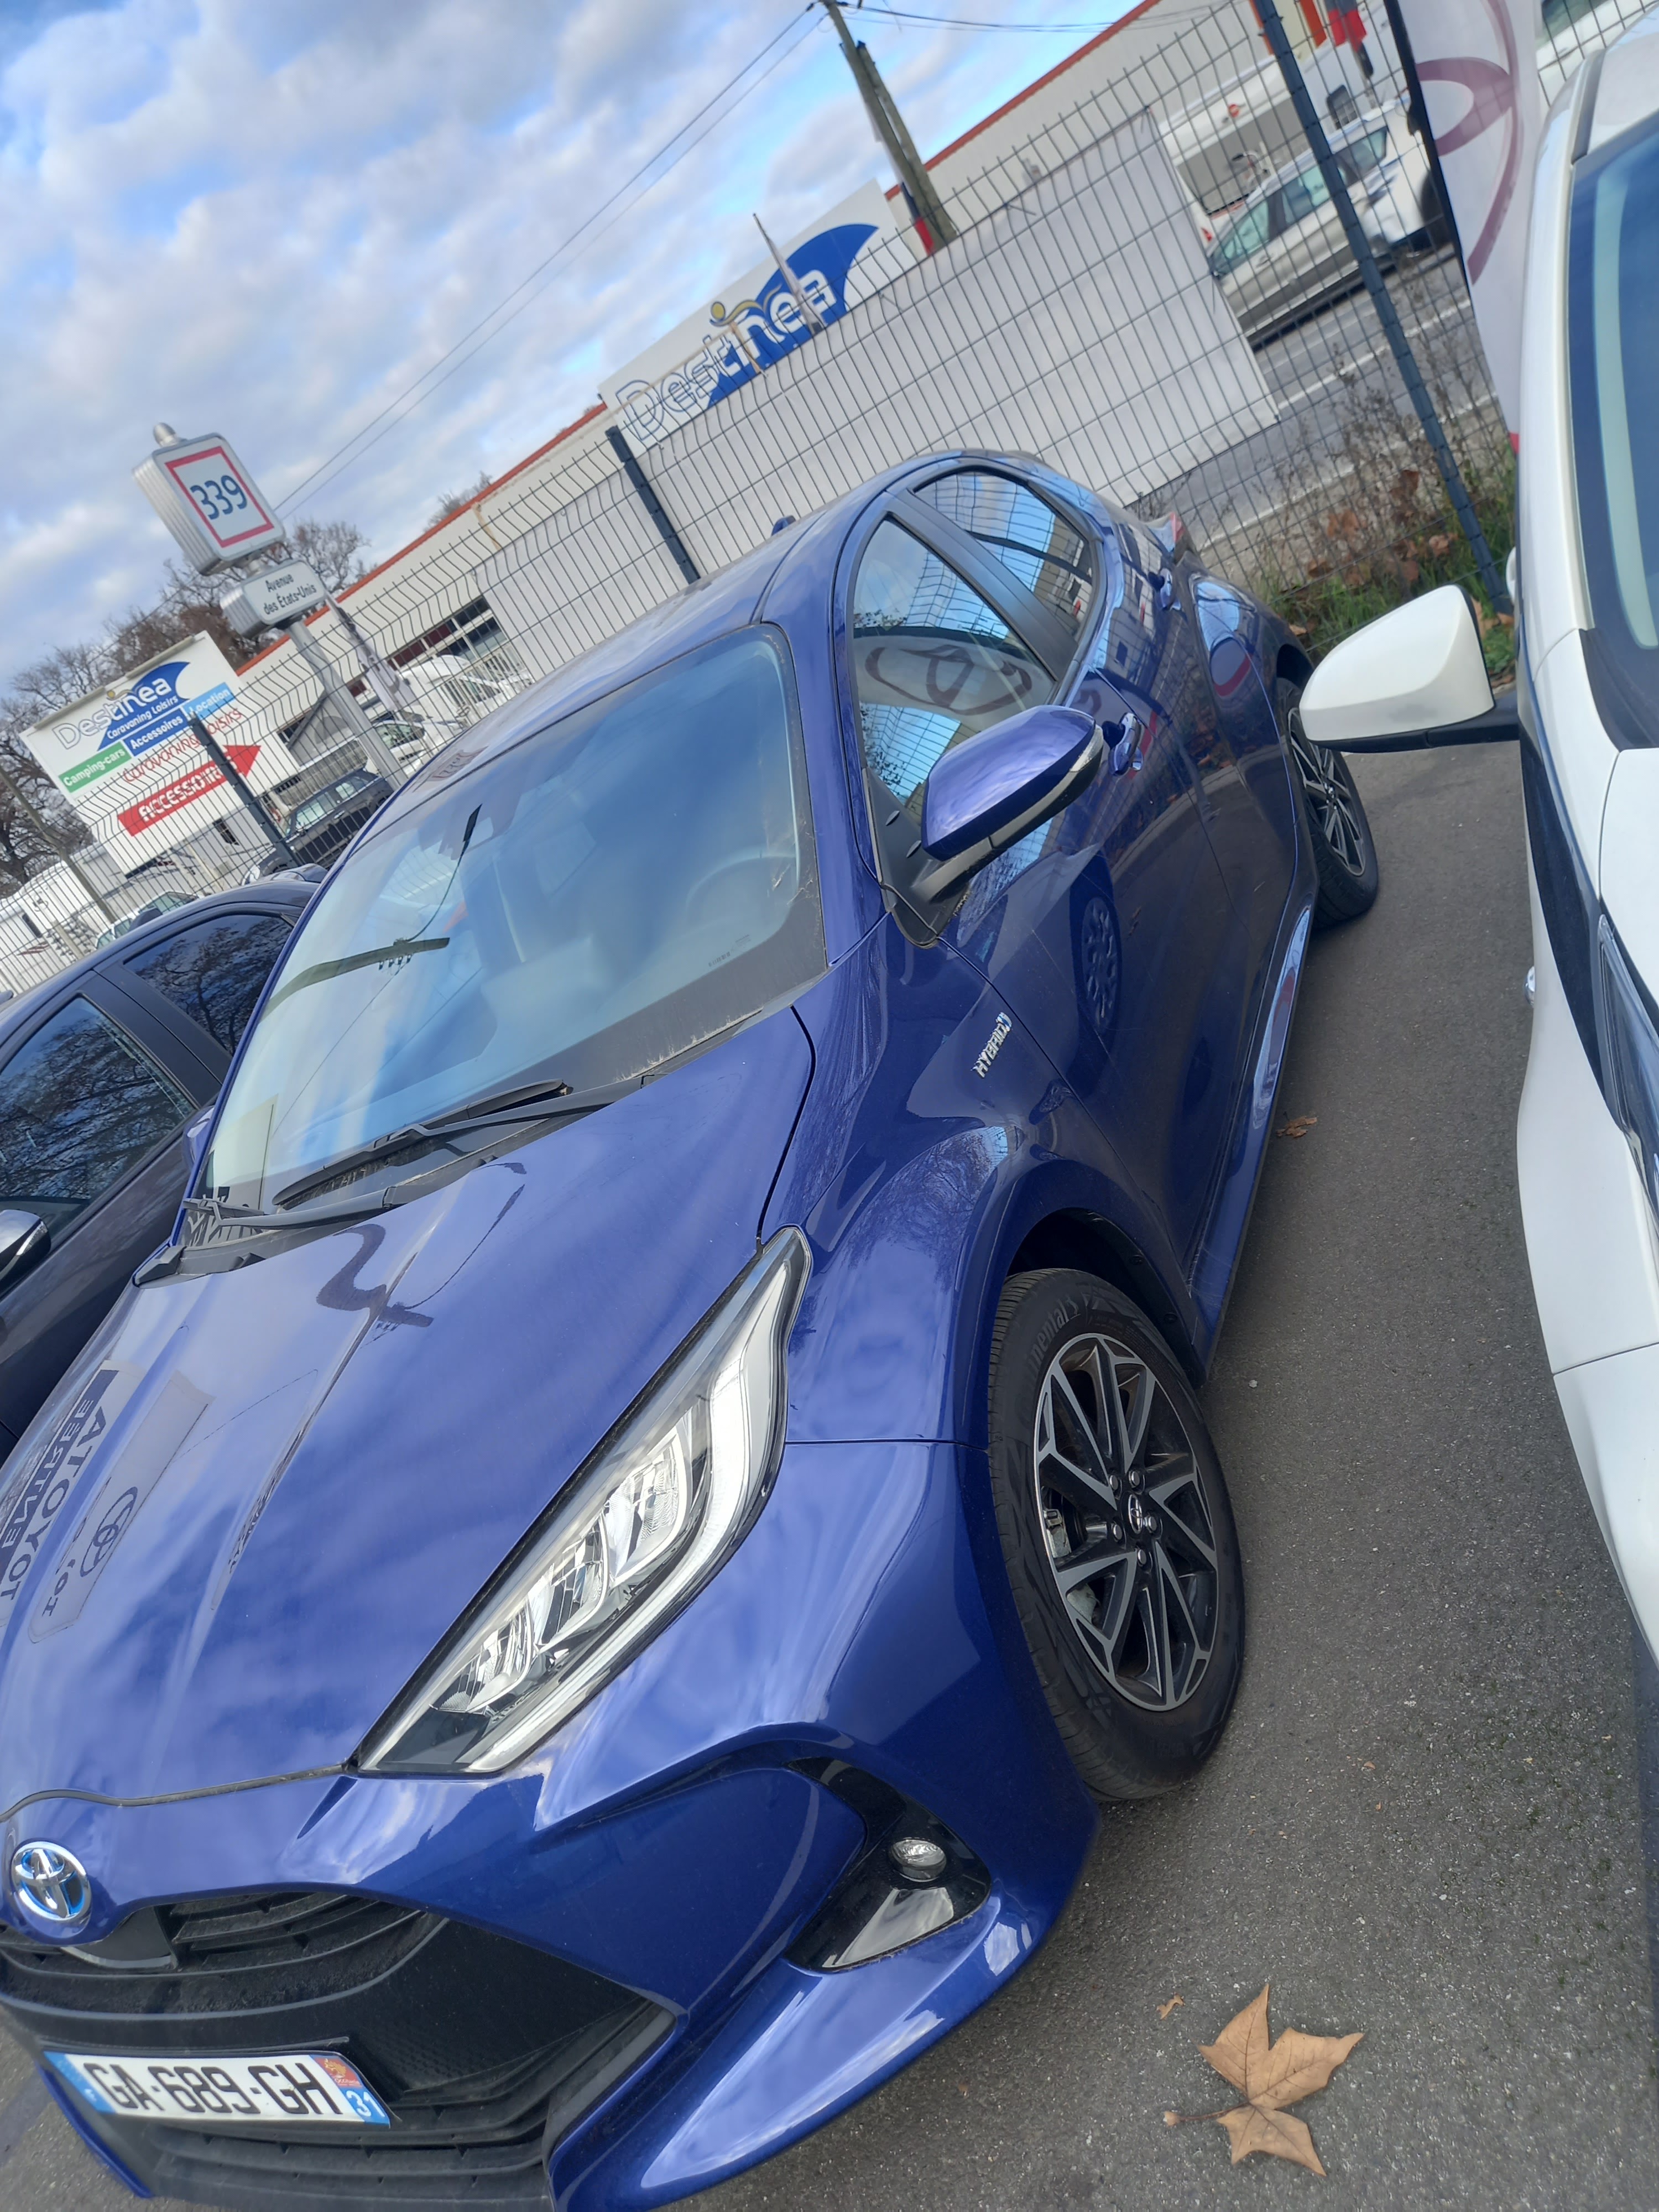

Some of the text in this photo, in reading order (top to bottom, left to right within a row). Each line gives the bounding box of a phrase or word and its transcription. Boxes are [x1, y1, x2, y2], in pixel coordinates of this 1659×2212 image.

[615, 269, 837, 441] Destinea
[190, 474, 247, 520] 339
[264, 583, 317, 615] des États-Unis
[265, 574, 294, 593] Avenue
[52, 678, 172, 750] Destinea
[107, 696, 179, 739] Caravaning Loisirs
[129, 715, 183, 750] Accessoires
[207, 708, 242, 735] oisirs
[63, 749, 126, 786] Camping-cars
[138, 754, 238, 823] ACCESSOIRS
[971, 1011, 1012, 1078] HYBRID
[346, 2090, 385, 2117] 31
